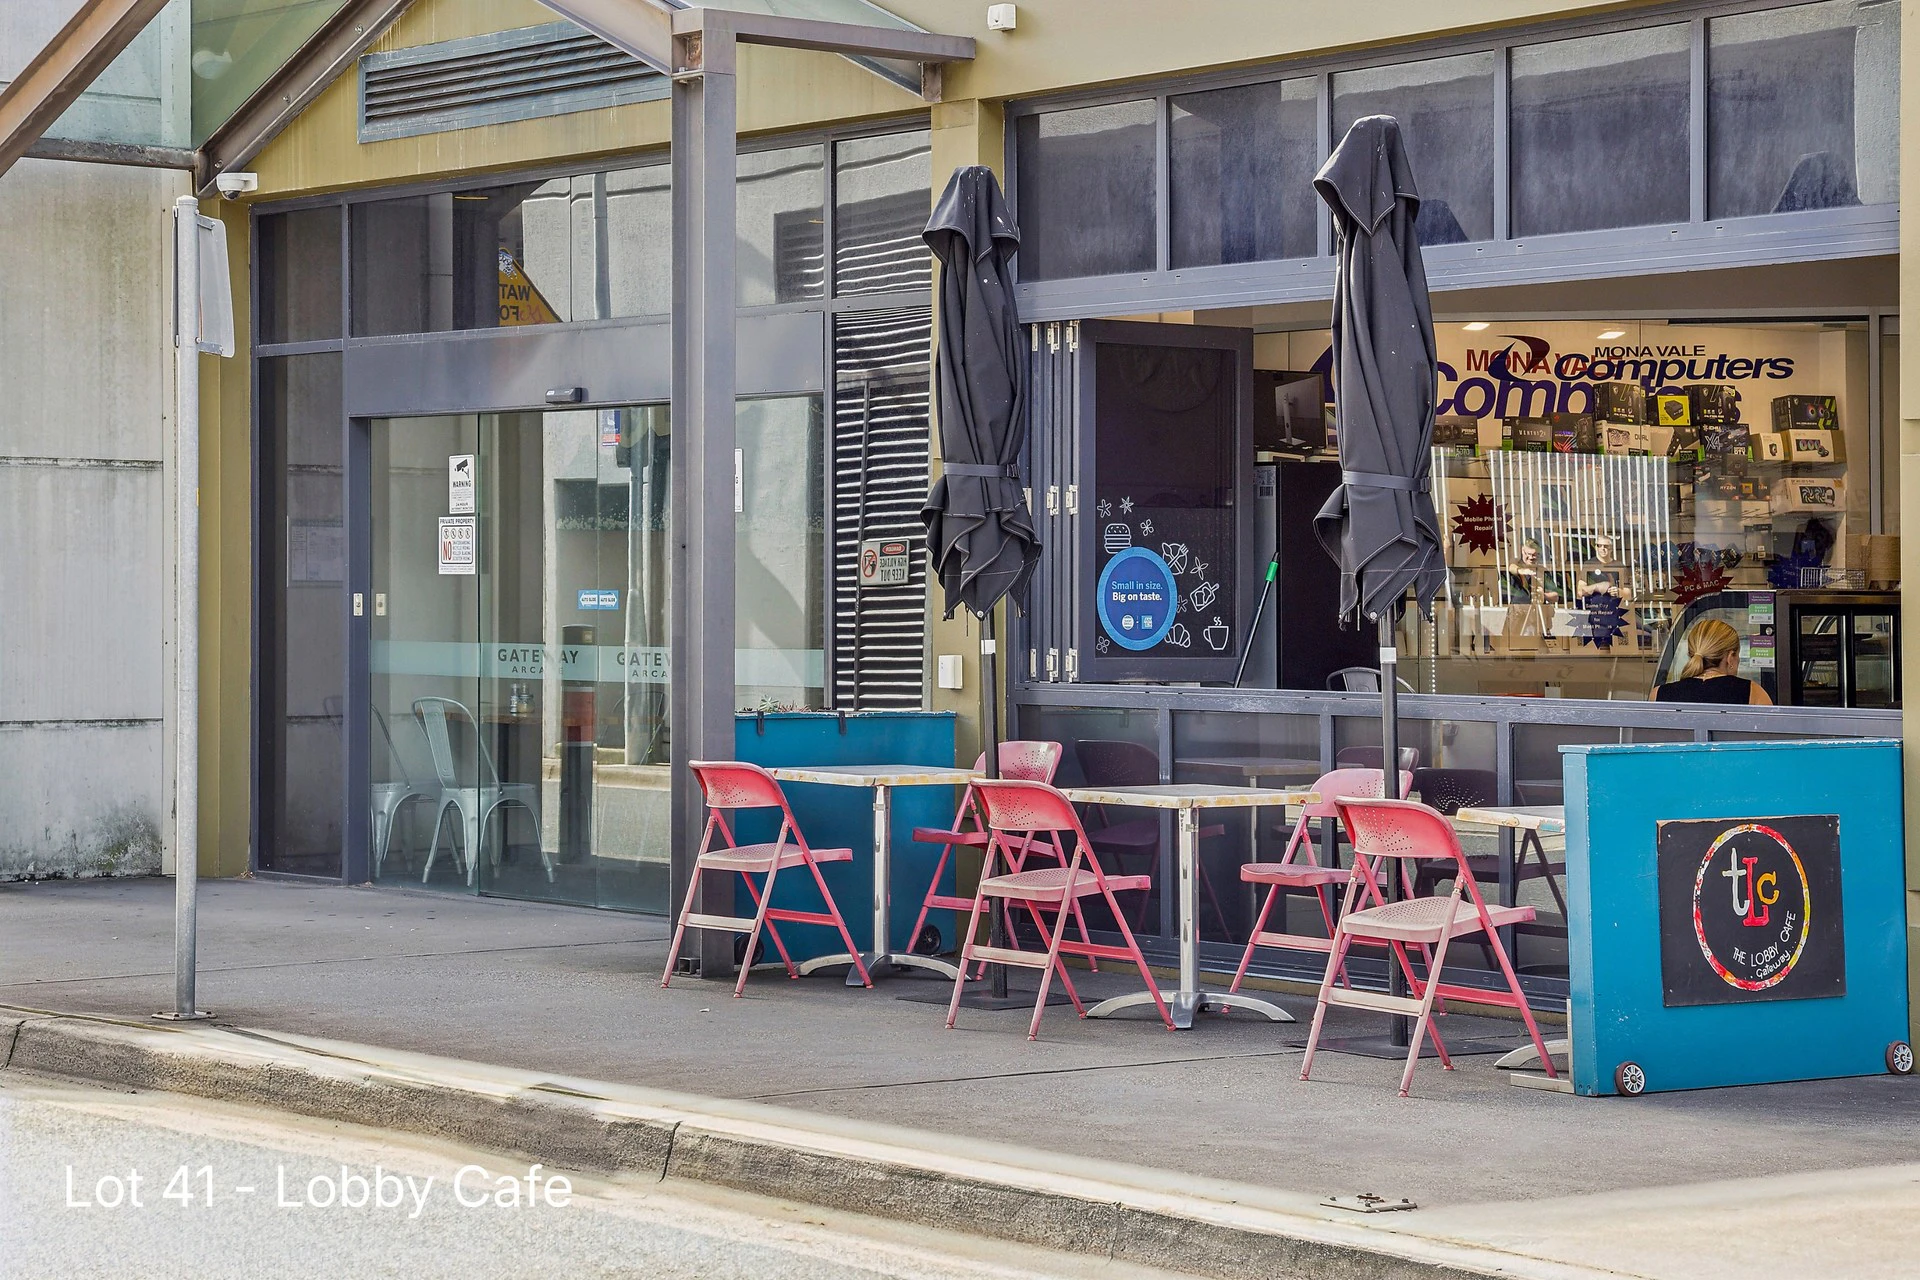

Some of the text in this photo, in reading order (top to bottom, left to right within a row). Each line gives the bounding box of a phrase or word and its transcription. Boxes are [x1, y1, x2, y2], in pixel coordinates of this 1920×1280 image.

[1595, 344, 1706, 358] MONA VALE
[1554, 353, 1795, 388] Computers
[443, 540, 452, 560] NO
[1111, 580, 1163, 590] Small in size.
[1684, 583, 1695, 592] PC
[1703, 579, 1720, 588] MAC
[1112, 592, 1163, 603] Big on taste.
[498, 649, 579, 664] GATEAY
[512, 665, 563, 675] ARCAE
[1732, 910, 1797, 968] THE LOBBY CAFE
